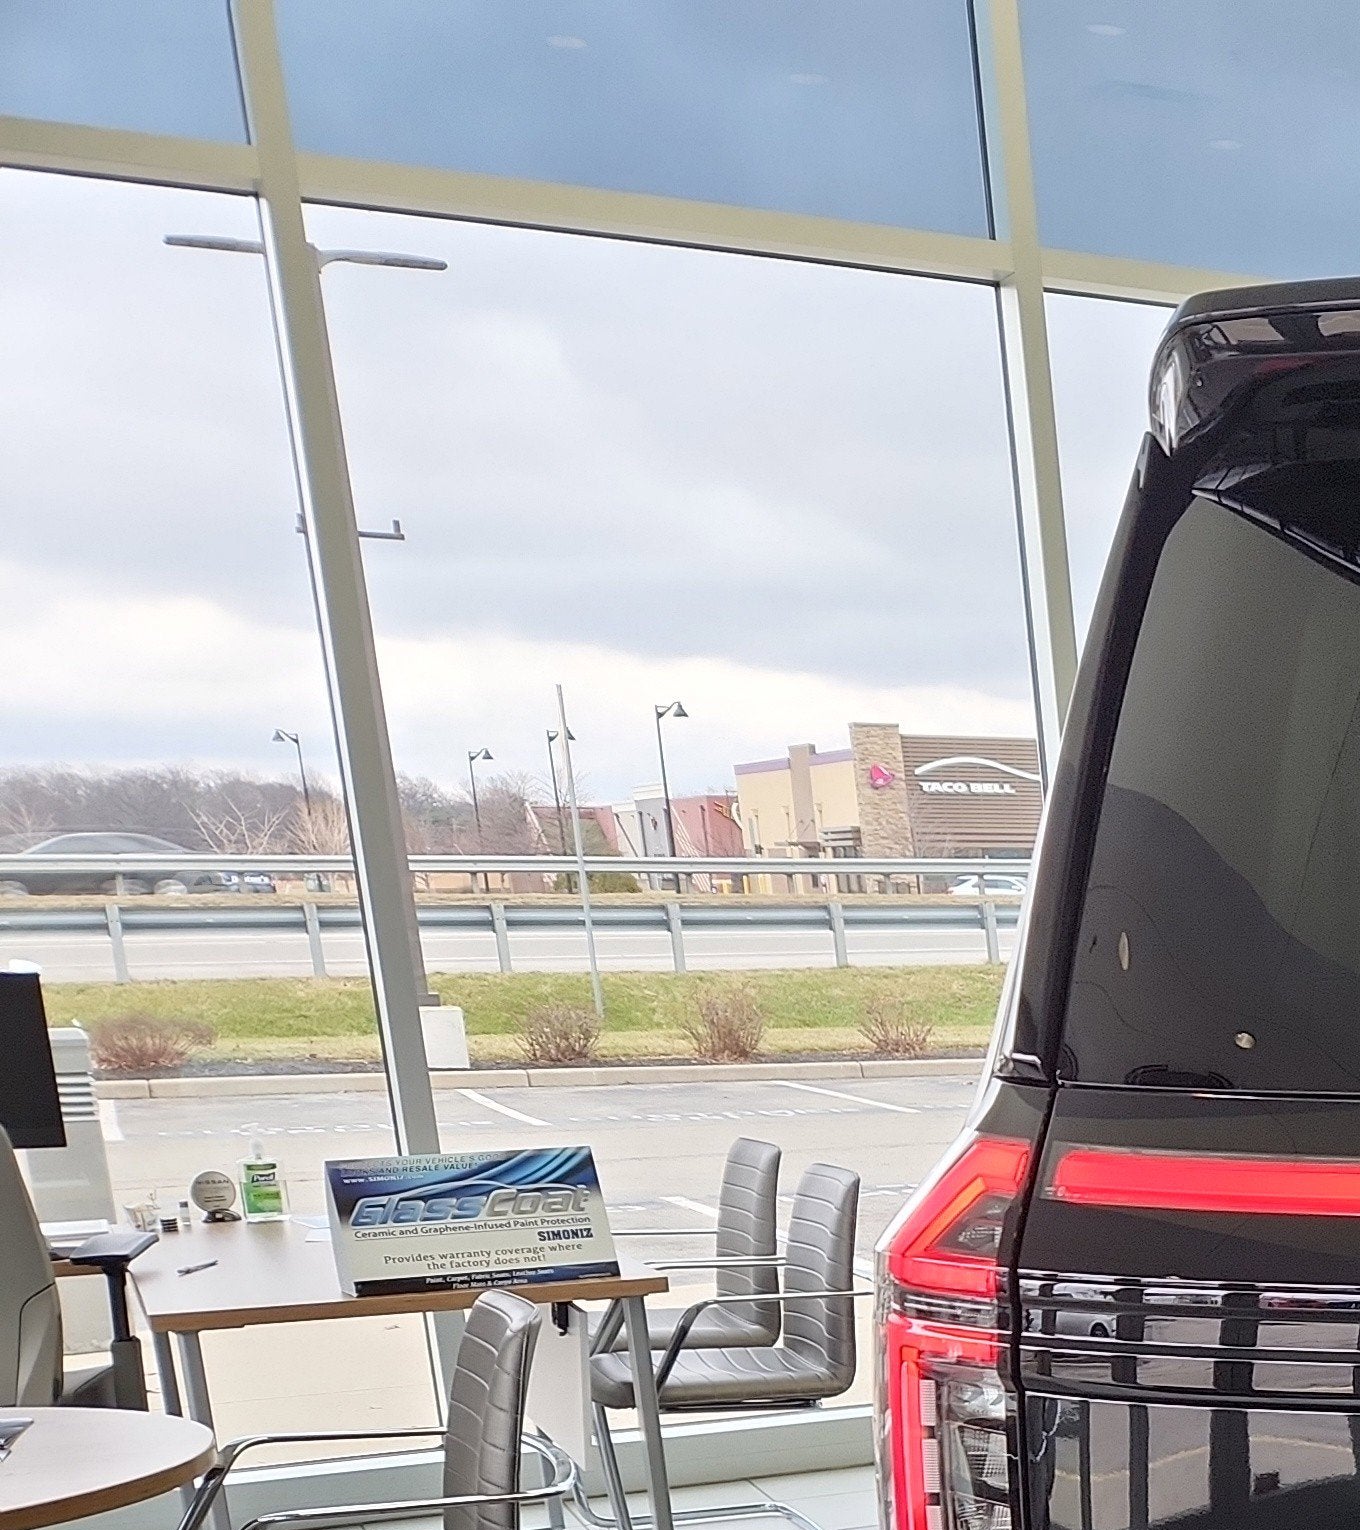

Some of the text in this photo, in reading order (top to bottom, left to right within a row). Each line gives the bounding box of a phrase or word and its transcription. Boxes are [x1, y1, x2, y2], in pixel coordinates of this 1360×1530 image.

[919, 782, 1016, 794] TACO BELL
[380, 1166, 399, 1174] AND
[402, 1164, 439, 1173] RESALE
[354, 1215, 590, 1239] Ceramic and Graphene-Infused Paint Protection
[537, 1228, 594, 1242] SIMONIZ
[384, 1241, 583, 1264] Provides warranty coverage where
[427, 1253, 546, 1270] the factory does not!
